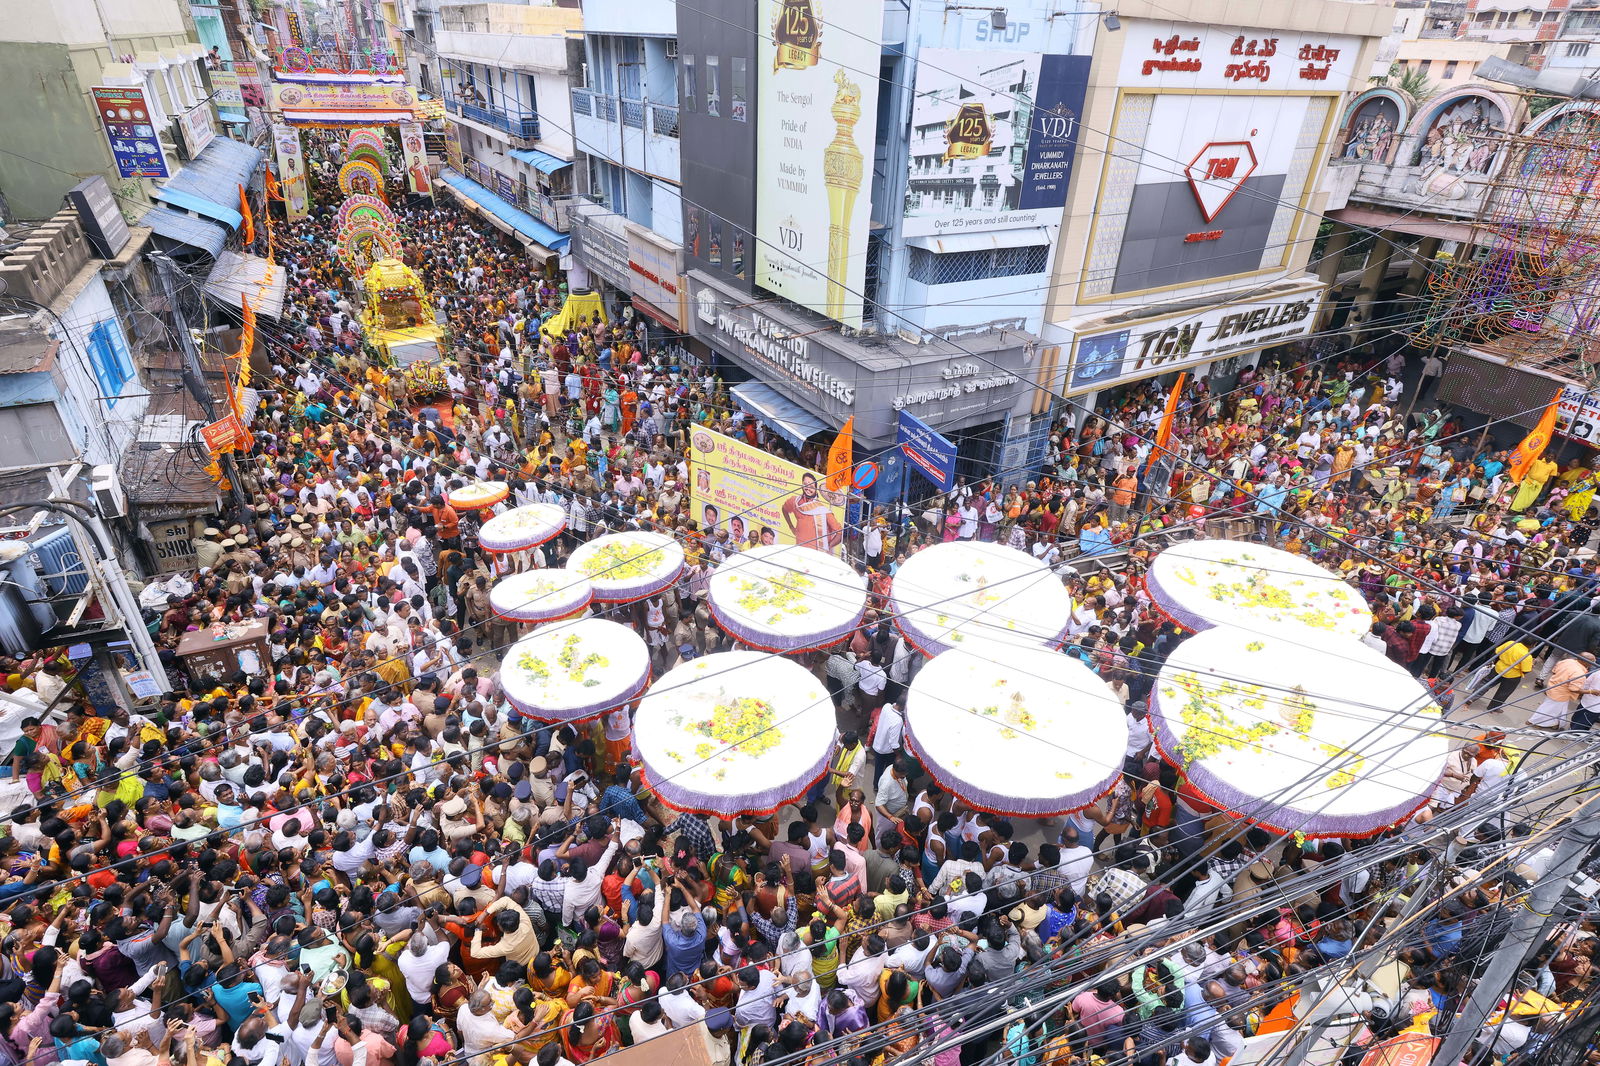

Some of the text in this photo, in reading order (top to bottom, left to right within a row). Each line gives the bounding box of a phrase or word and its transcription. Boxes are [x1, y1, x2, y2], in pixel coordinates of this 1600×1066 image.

[785, 6, 809, 36] 125
[788, 50, 807, 62] LEGACY
[777, 90, 813, 109] The Sengol
[781, 119, 808, 134] Pride of
[959, 117, 983, 137] 125
[1041, 117, 1075, 138] VDJ
[783, 137, 803, 151] INDIA
[960, 146, 979, 154] LEGACY
[1039, 151, 1065, 160] VUMMIDI
[779, 162, 807, 181] Made by
[1031, 161, 1069, 170] DWARKANATH
[1204, 156, 1240, 181] TGN
[1032, 171, 1064, 181] JEWELLERS
[777, 177, 808, 195] VUMMIDI
[934, 213, 1038, 229] Over 125 years and still counting!
[779, 225, 803, 252] VDJ
[1207, 297, 1315, 342] JEWELLERS
[1133, 321, 1203, 370] TGN
[718, 313, 791, 369] DWARKANATH
[789, 355, 856, 406] JEWELLERS
[166, 526, 187, 537] SRI
